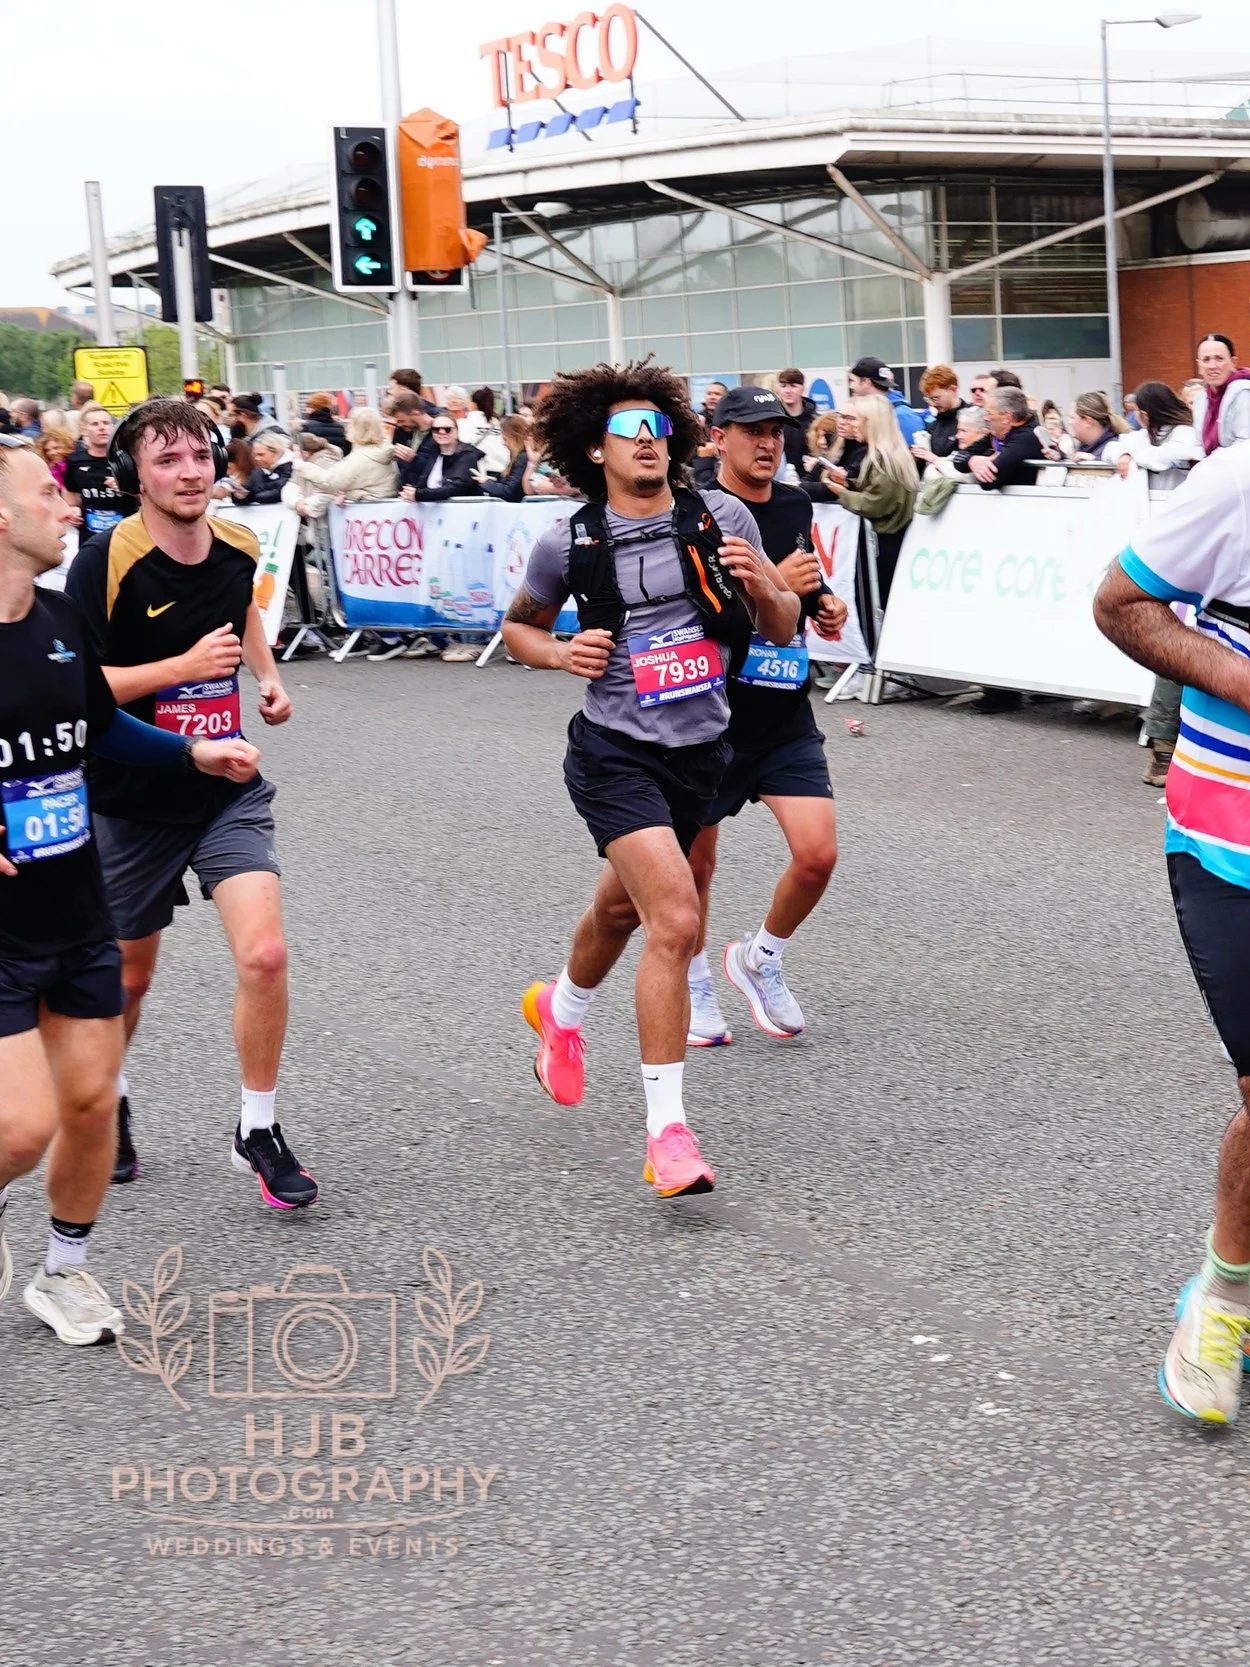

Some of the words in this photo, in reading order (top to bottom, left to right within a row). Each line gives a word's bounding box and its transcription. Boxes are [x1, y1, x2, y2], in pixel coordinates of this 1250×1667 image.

[479, 3, 638, 109] TESCO
[633, 651, 678, 668] JOSHUA
[653, 655, 709, 687] 7939
[757, 658, 800, 678] 4516
[157, 703, 196, 714] JAMES
[176, 710, 232, 736] 7203
